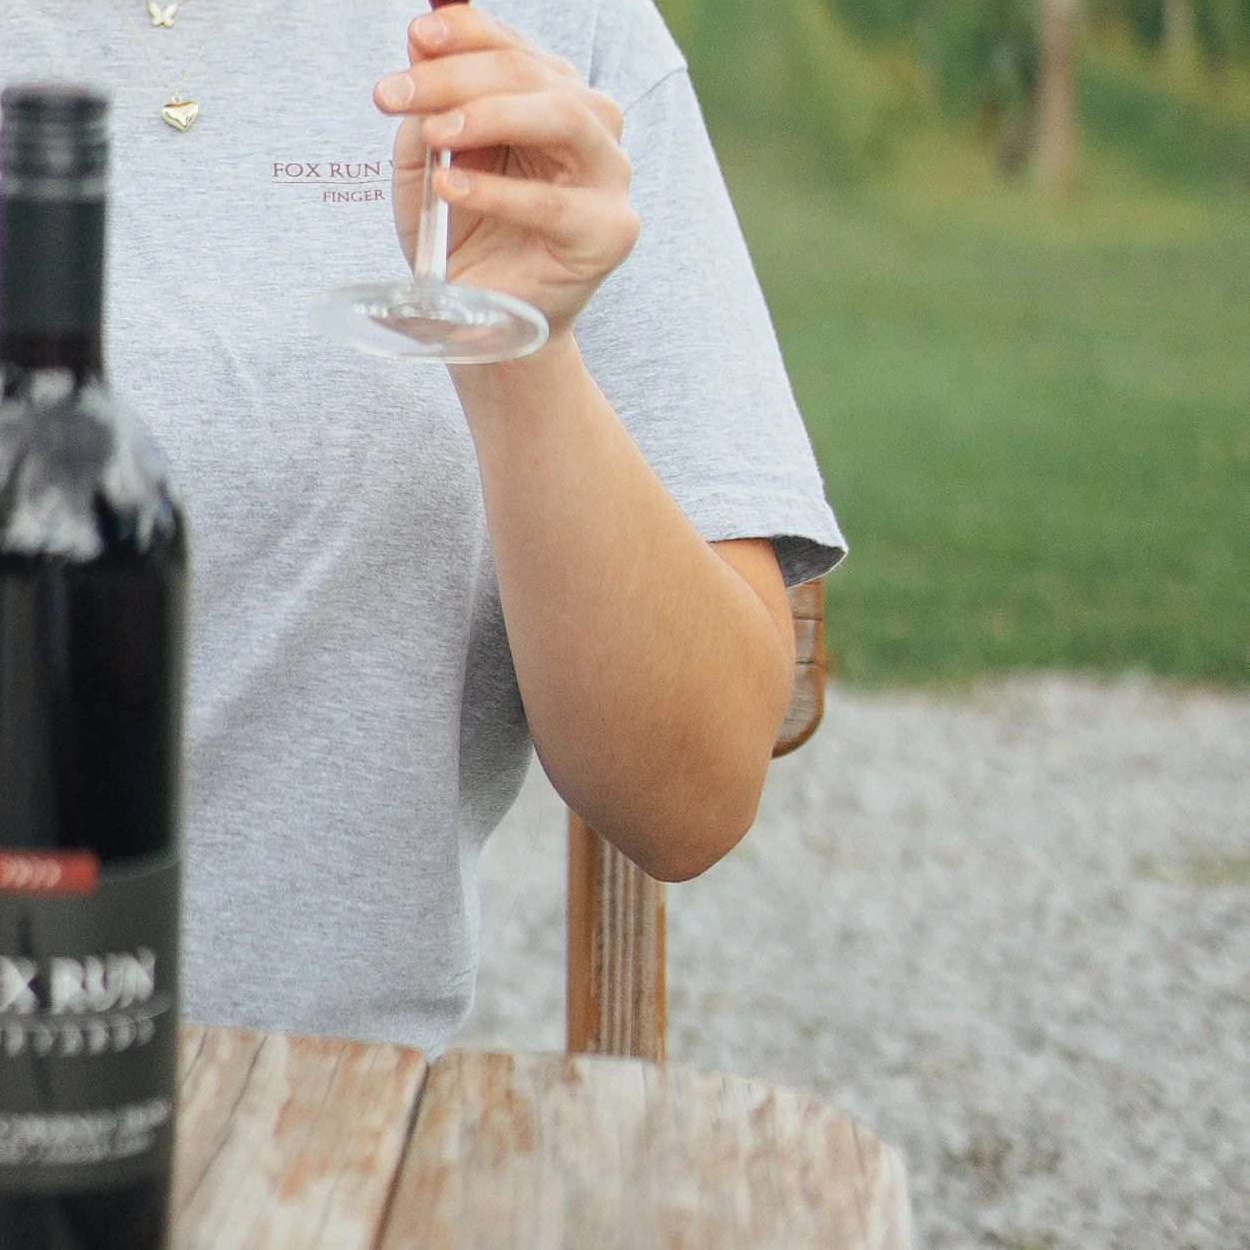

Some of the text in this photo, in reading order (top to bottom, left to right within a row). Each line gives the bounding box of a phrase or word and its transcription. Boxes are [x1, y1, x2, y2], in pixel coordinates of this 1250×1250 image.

[272, 162, 321, 178] FOX
[329, 161, 381, 179] RUN
[322, 189, 385, 203] FINGER
[50, 945, 156, 1016] RUN
